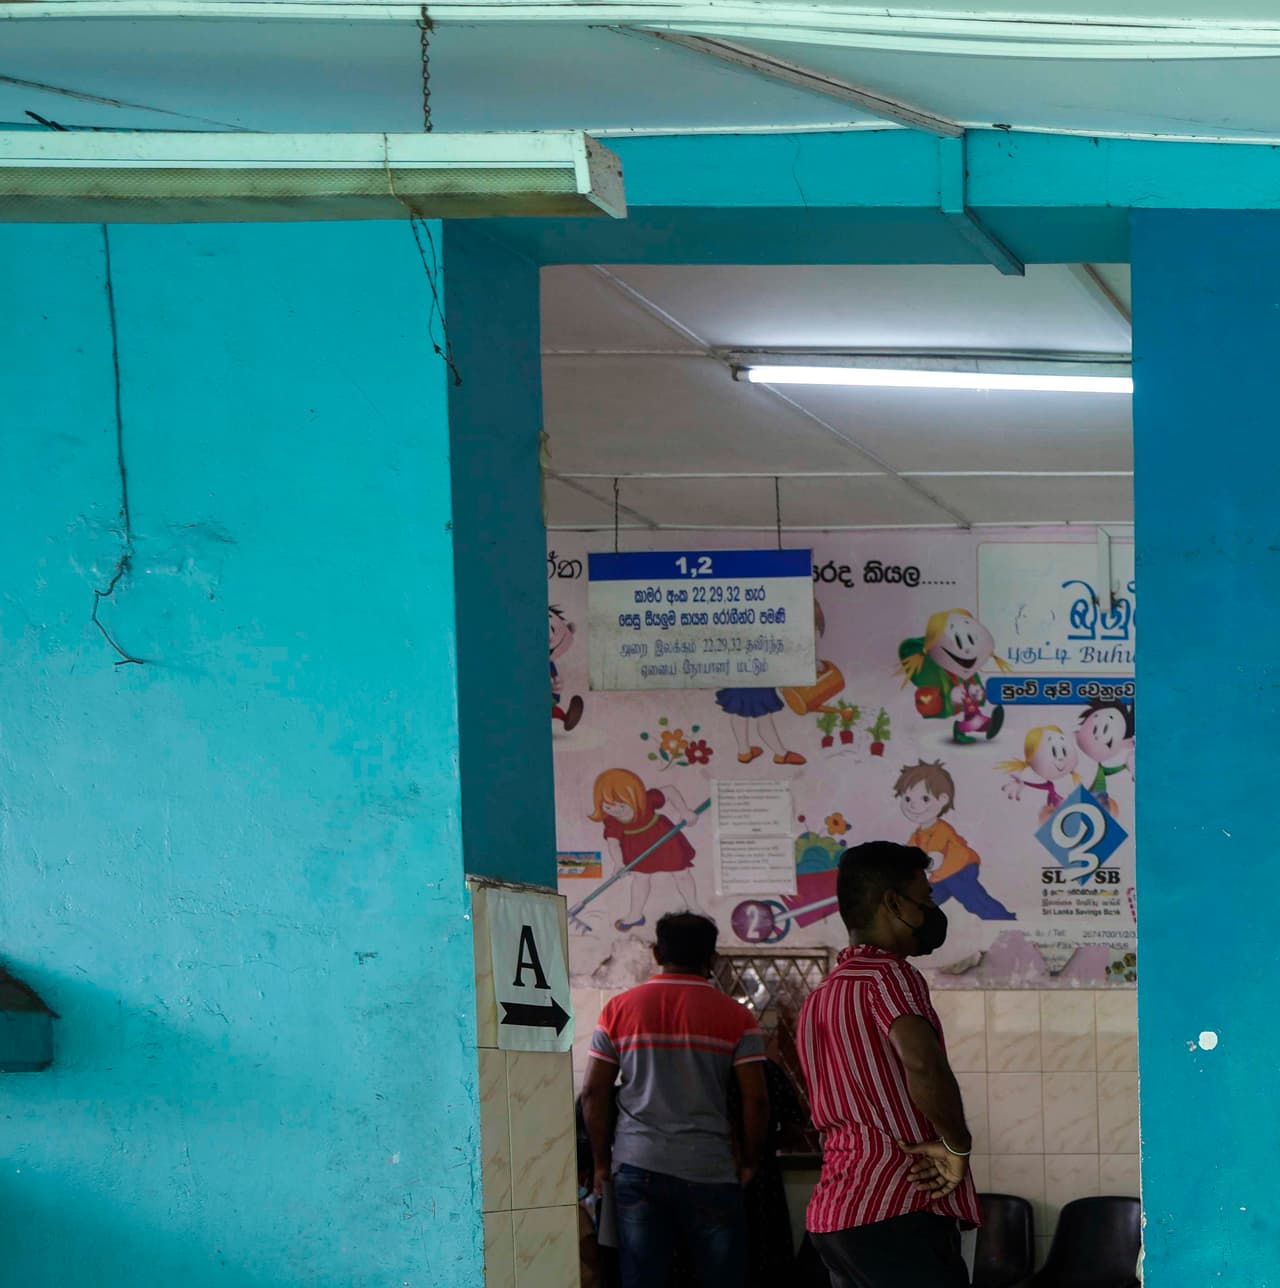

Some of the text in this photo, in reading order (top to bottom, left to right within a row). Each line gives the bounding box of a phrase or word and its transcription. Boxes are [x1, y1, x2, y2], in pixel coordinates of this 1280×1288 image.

[675, 556, 713, 577] 1,2
[634, 587, 662, 603] කාමර
[666, 588, 688, 604] අංක
[746, 904, 760, 939] 2
[513, 925, 551, 989] A
